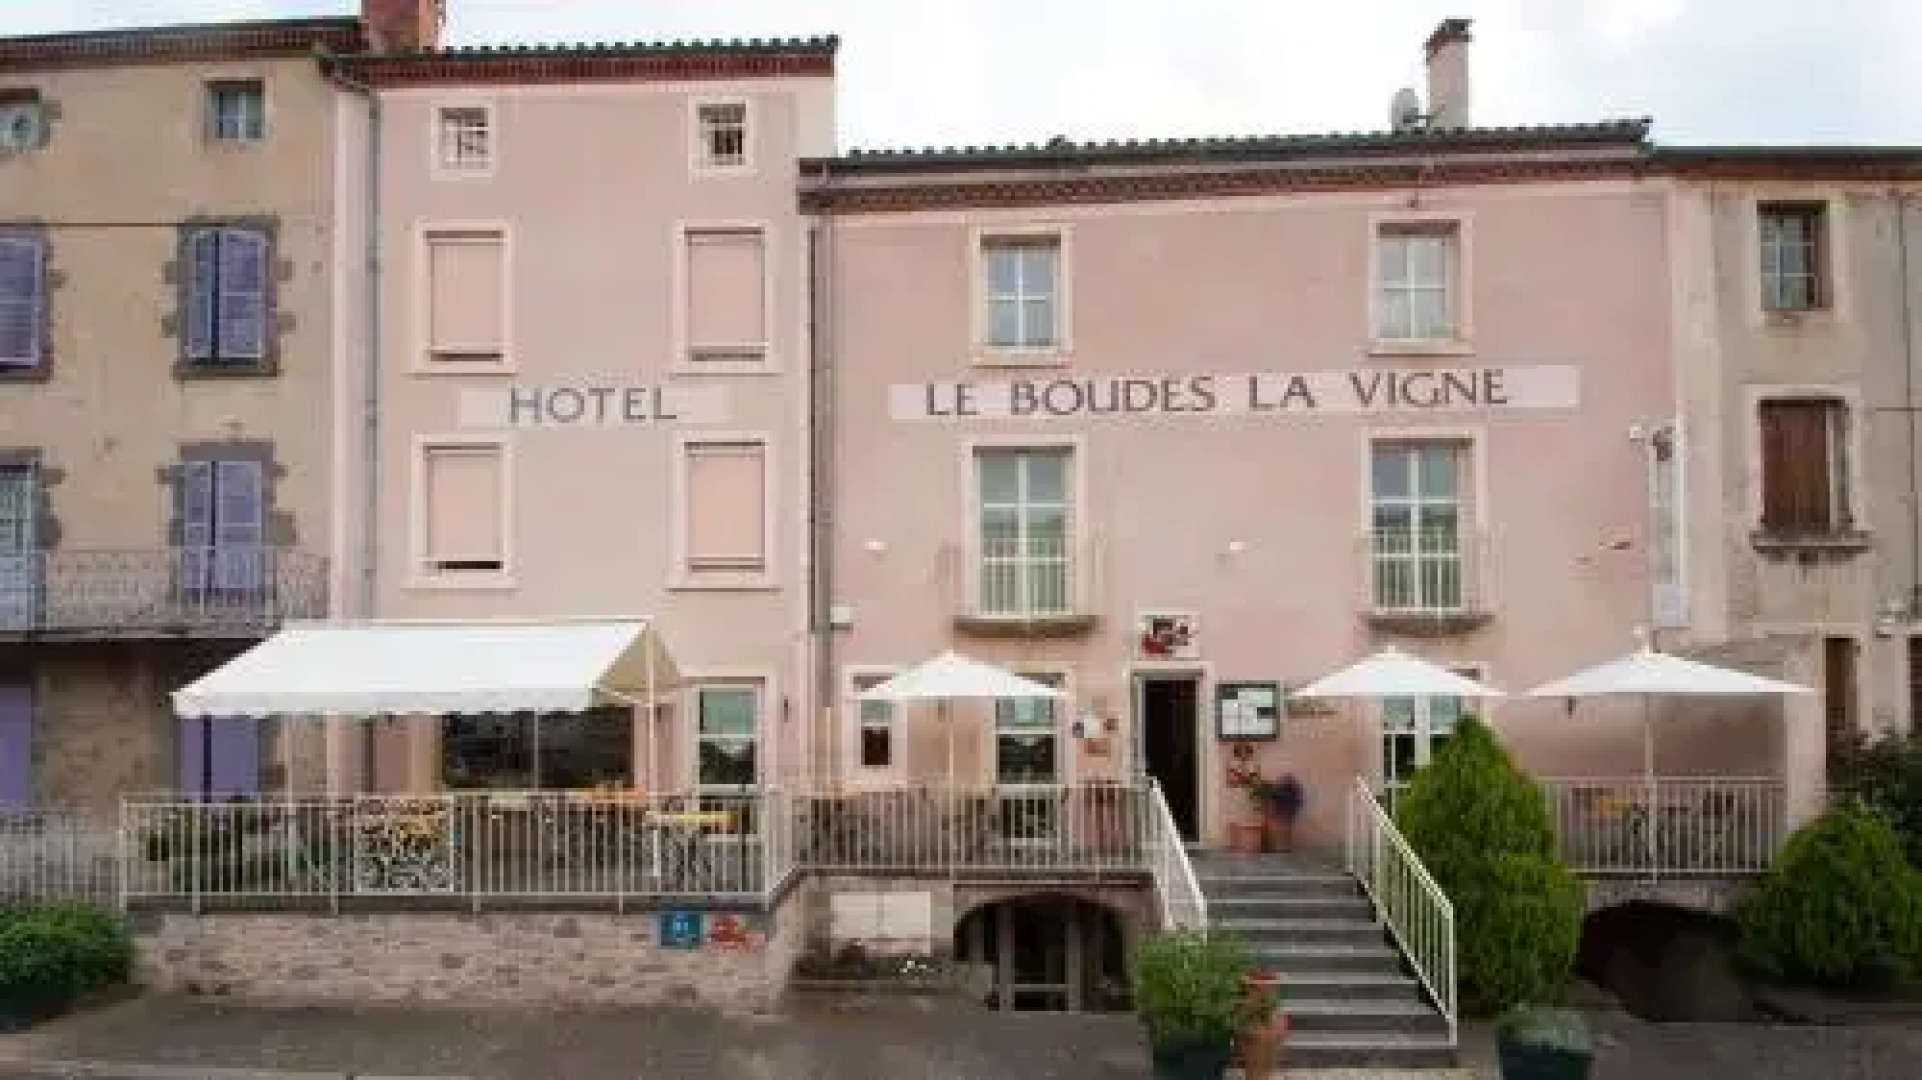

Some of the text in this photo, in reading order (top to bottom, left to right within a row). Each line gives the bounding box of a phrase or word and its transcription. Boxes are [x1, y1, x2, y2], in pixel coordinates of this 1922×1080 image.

[509, 386, 678, 424] HOTEL
[925, 369, 1509, 416] LE BOUDES LA VIGNE
